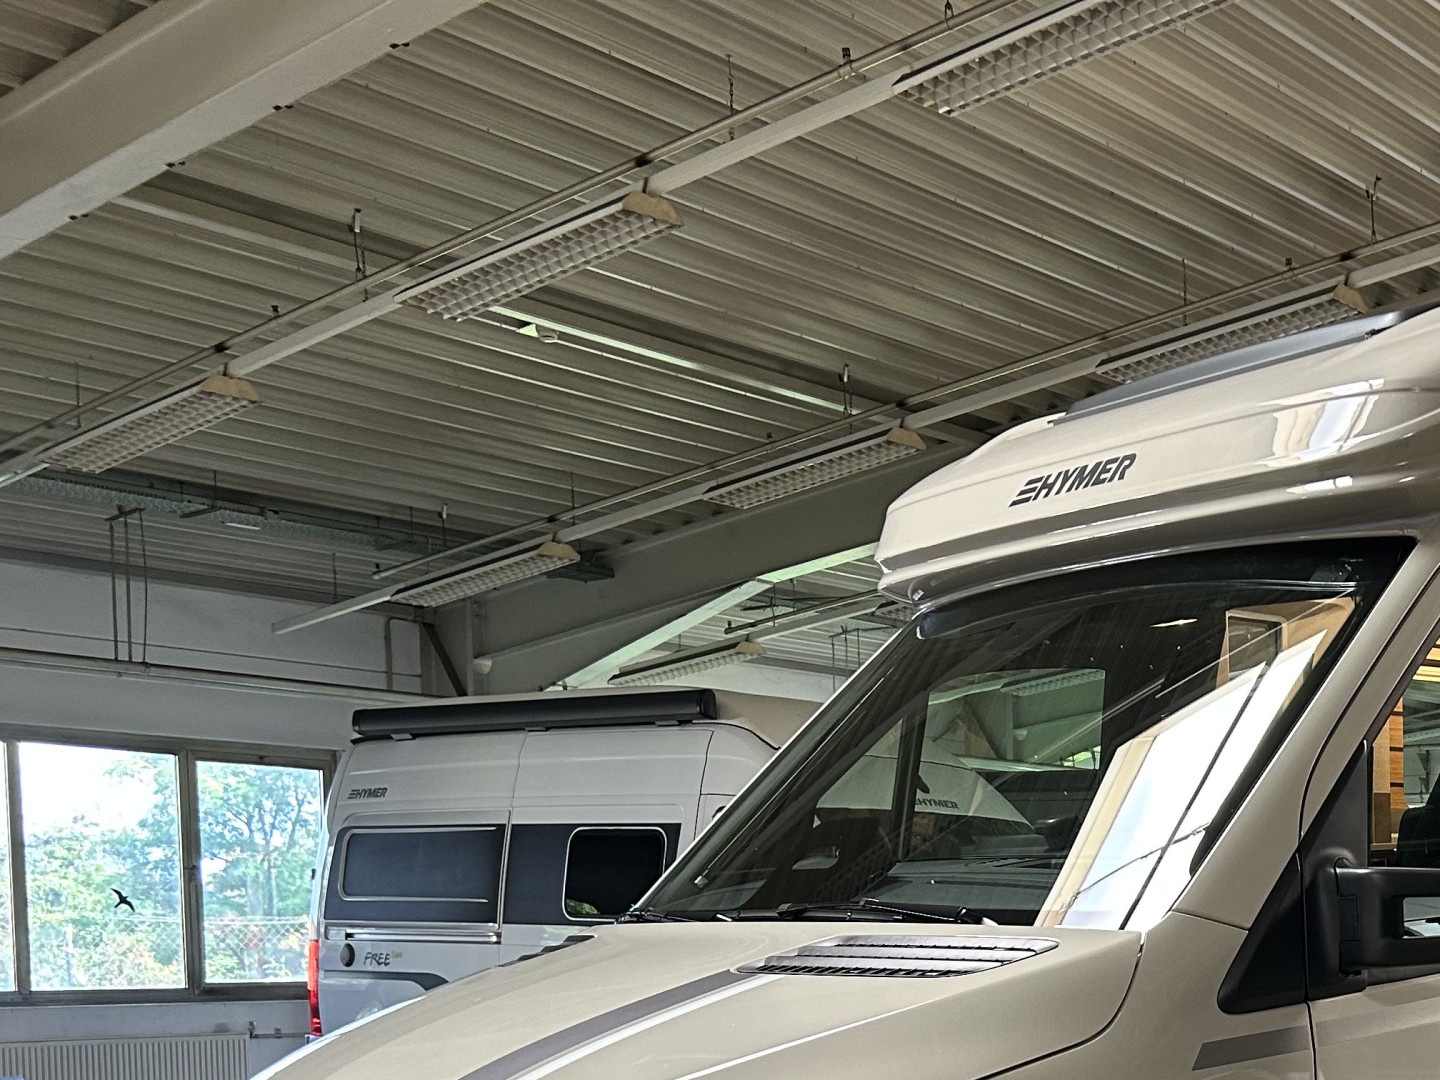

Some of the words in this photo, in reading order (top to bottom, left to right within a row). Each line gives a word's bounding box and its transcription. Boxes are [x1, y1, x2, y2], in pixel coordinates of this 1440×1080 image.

[1031, 452, 1137, 502] HYMER
[355, 787, 388, 799] HYMER
[363, 951, 391, 967] FREE
